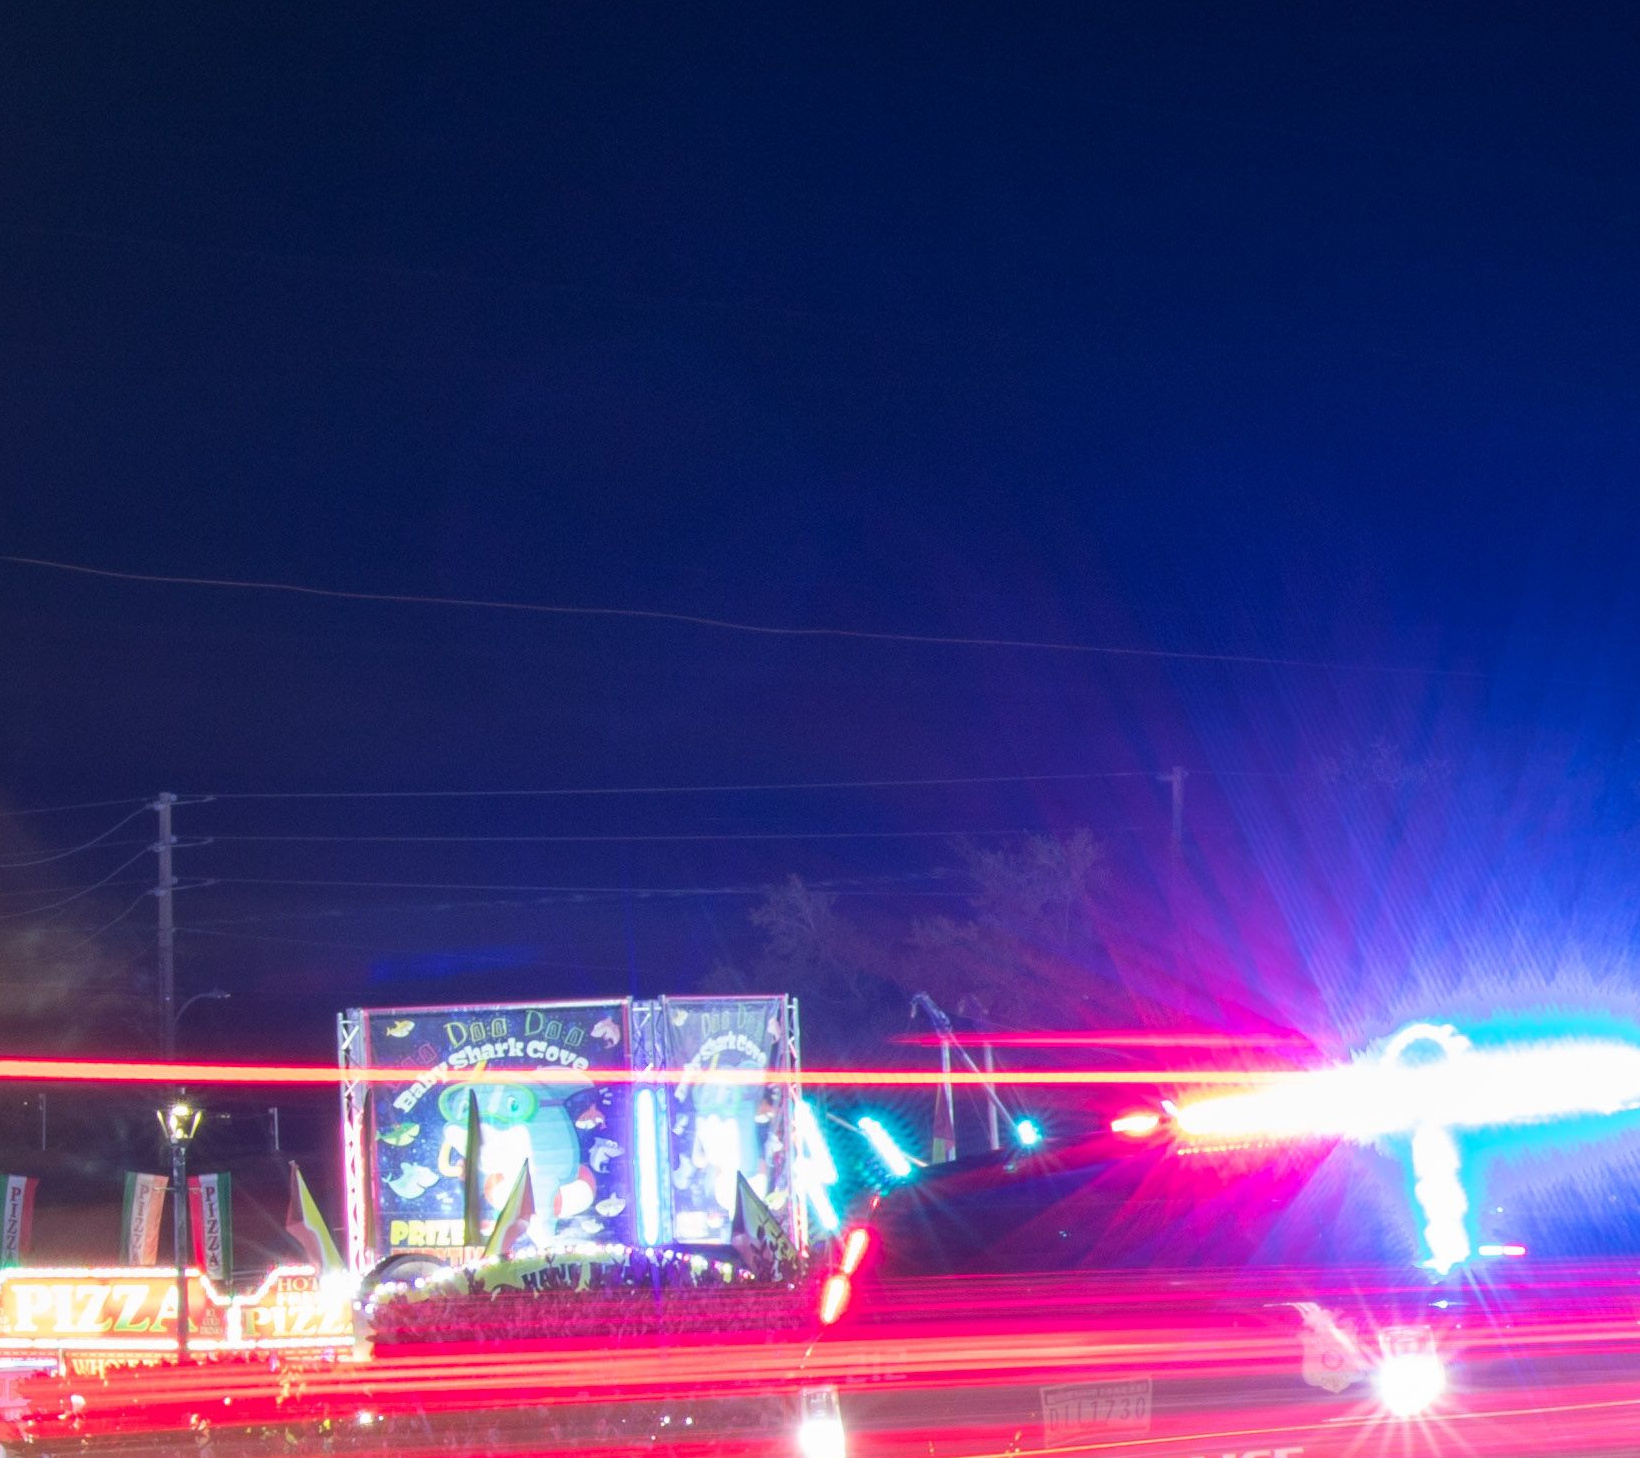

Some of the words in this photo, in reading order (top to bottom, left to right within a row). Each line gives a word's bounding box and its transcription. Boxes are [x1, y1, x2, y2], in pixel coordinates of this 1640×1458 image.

[393, 1060, 450, 1114] Baby
[448, 1037, 525, 1071] Shark
[526, 1039, 590, 1072] Cove
[129, 1184, 150, 1265] PIZZA
[205, 1187, 220, 1267] PIZZA
[11, 1284, 199, 1333] PIZZA
